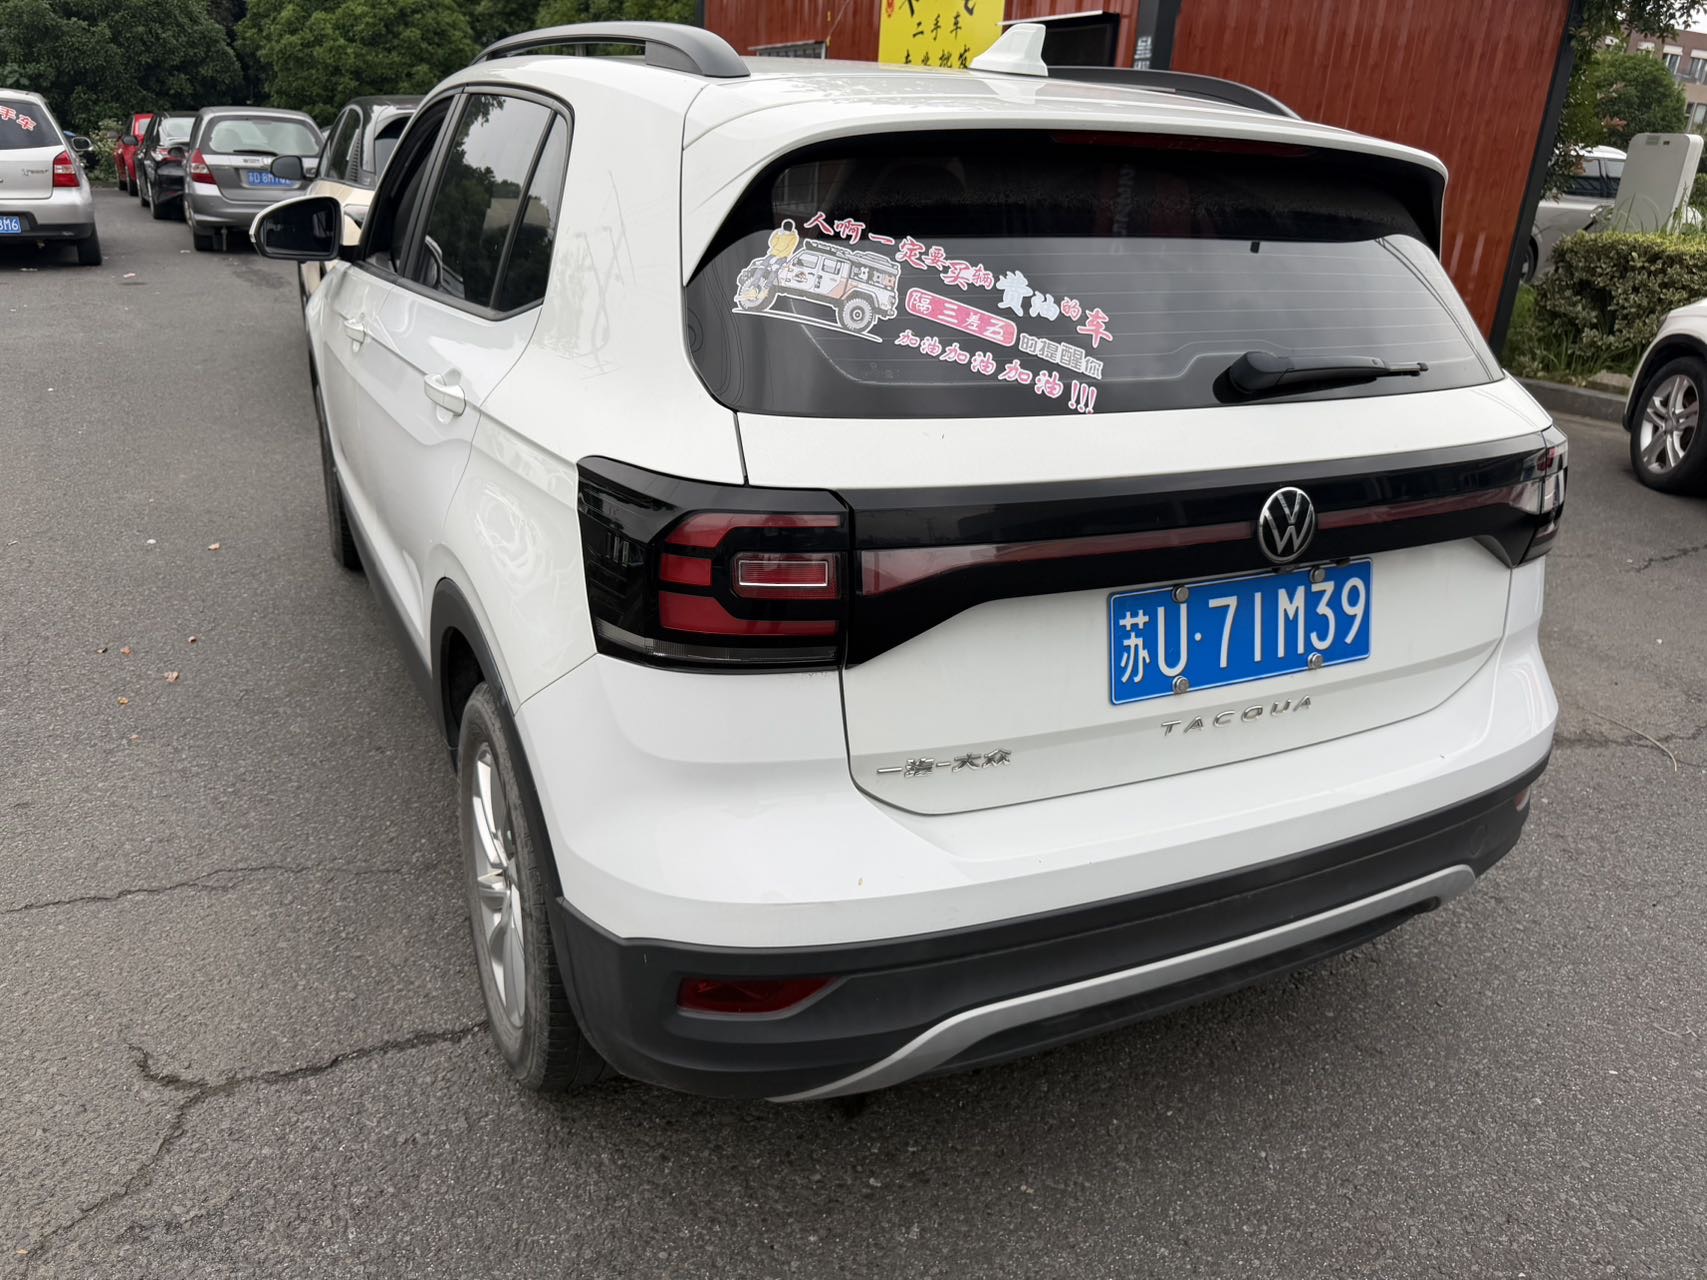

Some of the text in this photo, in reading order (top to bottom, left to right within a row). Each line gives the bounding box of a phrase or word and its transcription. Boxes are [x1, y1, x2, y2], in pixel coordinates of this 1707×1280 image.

[912, 11, 962, 41] 二手车
[1161, 695, 1313, 737] TACQUA
